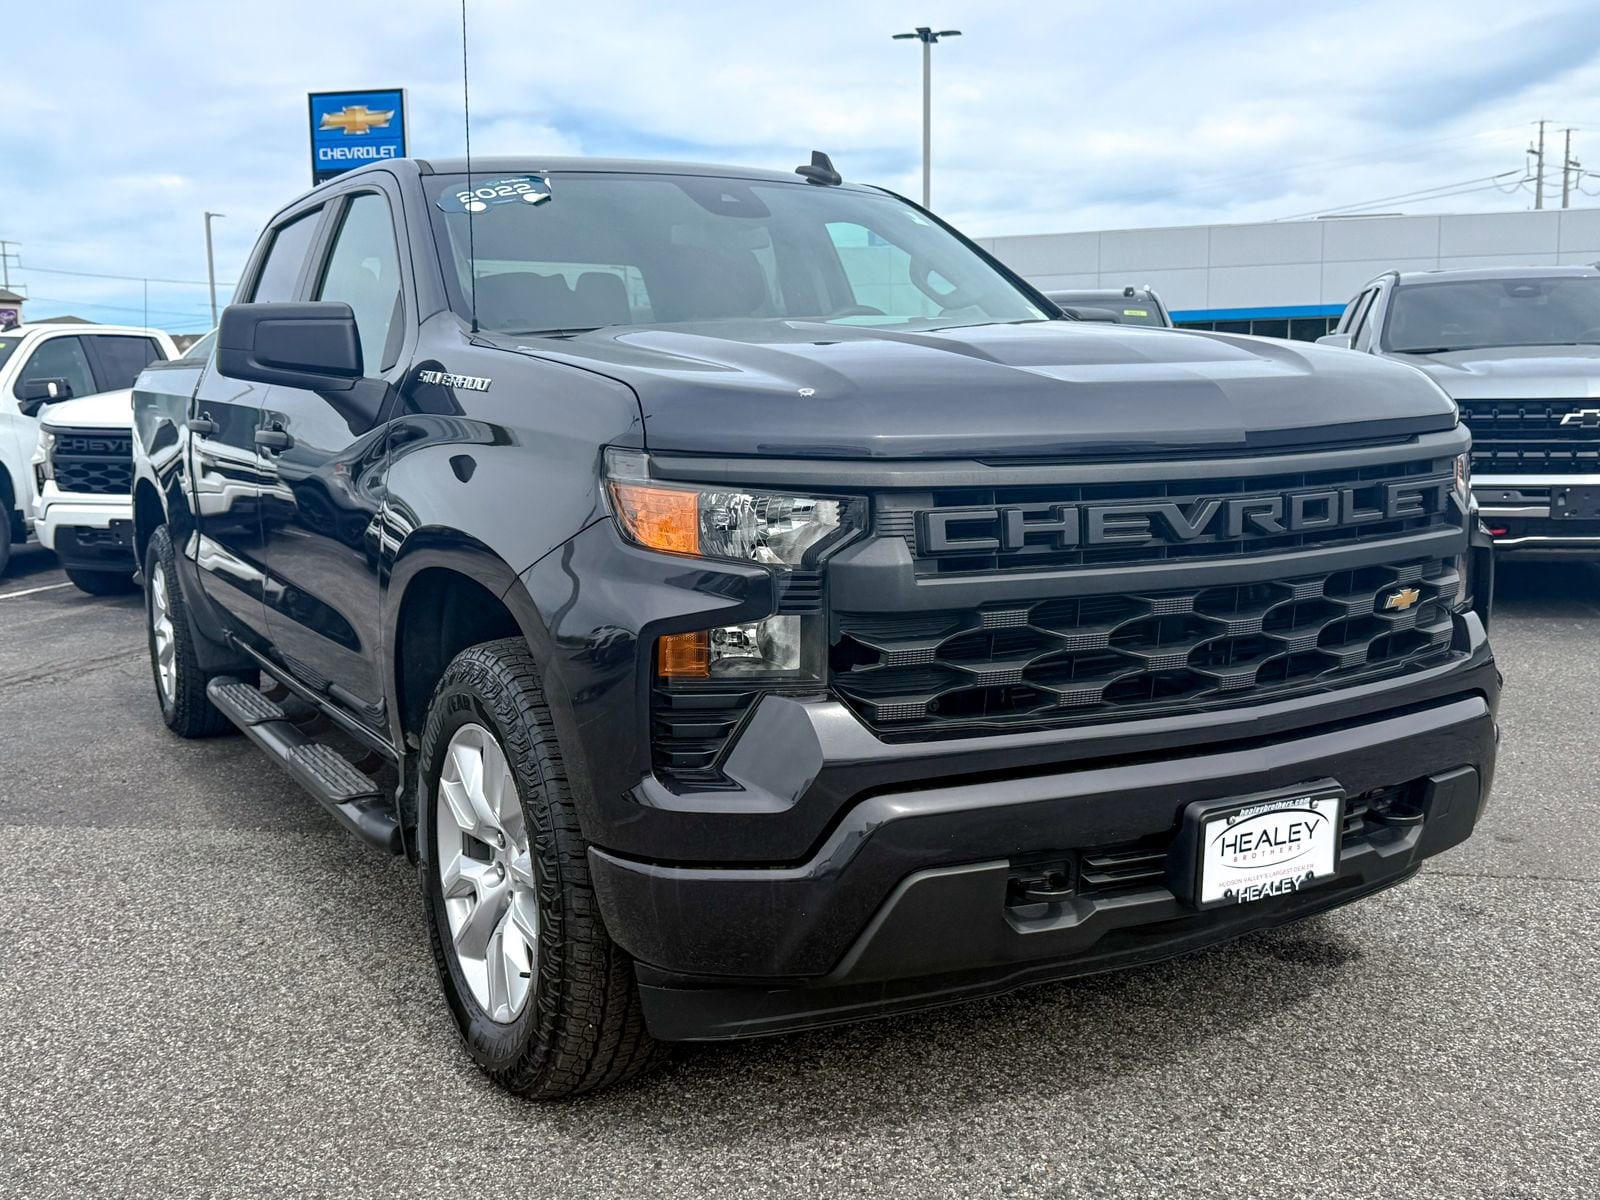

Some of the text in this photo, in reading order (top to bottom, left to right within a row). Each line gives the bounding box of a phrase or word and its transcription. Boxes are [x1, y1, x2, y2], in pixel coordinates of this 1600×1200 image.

[319, 145, 397, 160] CHEVROLET
[456, 183, 536, 203] 2022
[418, 370, 492, 391] SILVERADO
[921, 478, 1455, 552] CHEVROLET
[1239, 797, 1311, 817] healeybrothers.com
[1221, 819, 1320, 857] HEALEY
[1233, 844, 1302, 863] BROTHERS
[1237, 876, 1302, 903] HEALEY
